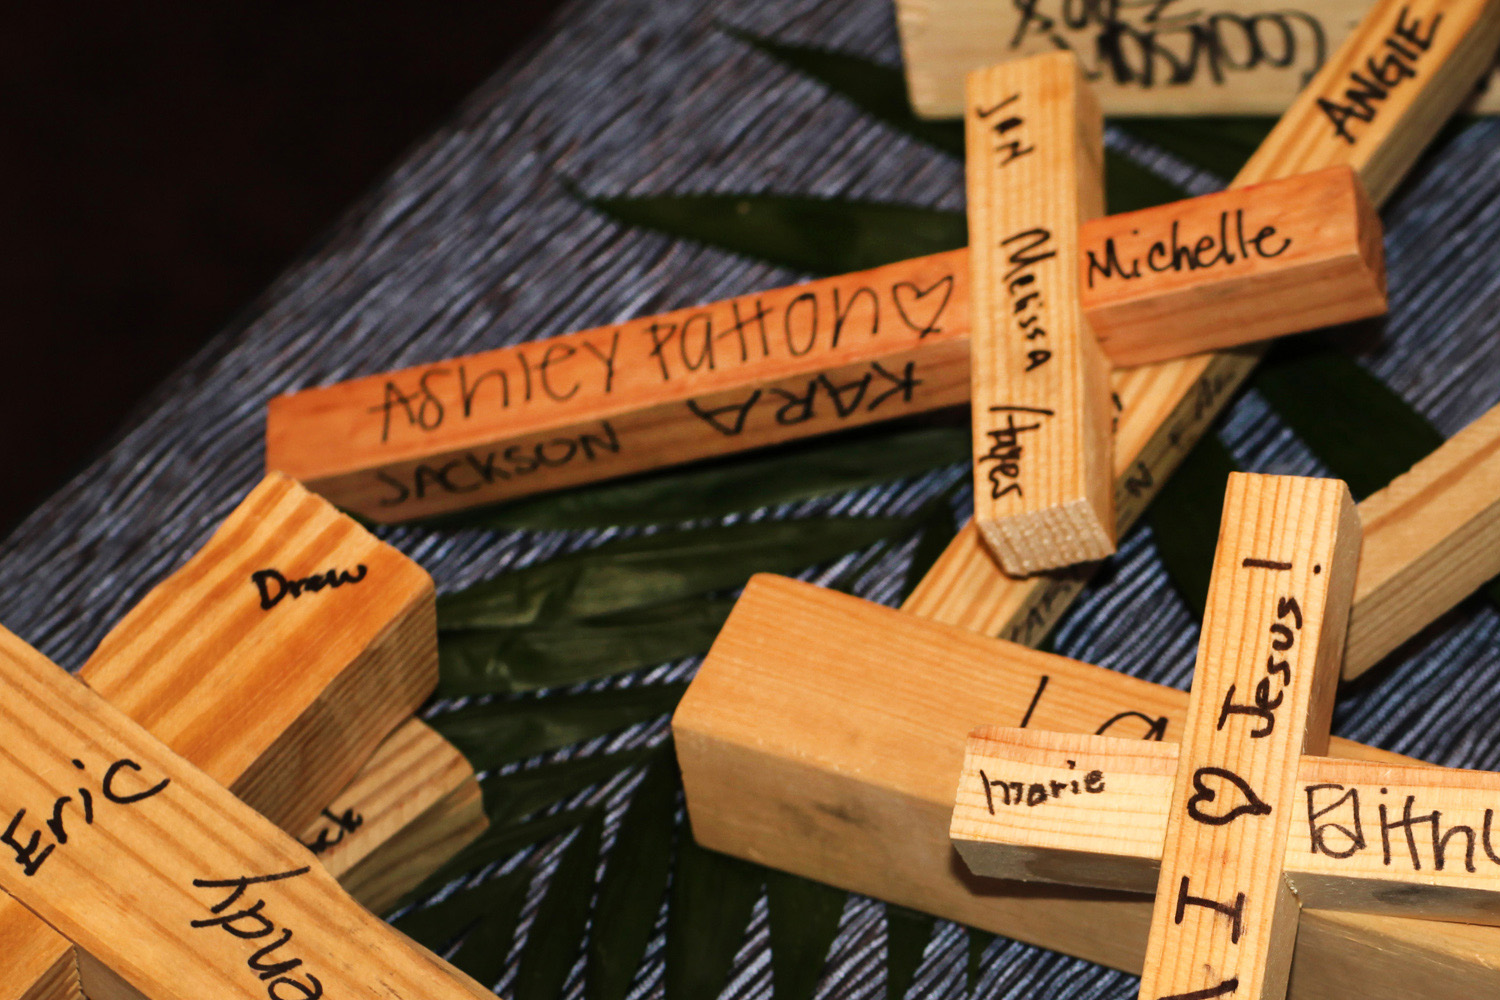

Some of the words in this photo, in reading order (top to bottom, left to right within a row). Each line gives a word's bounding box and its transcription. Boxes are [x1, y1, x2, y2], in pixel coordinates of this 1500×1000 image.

[1087, 209, 1291, 289] Michelle
[686, 362, 922, 436] KARA
[374, 422, 622, 506] JACKSON
[251, 564, 367, 611] Drew
[1, 757, 170, 876] Eric
